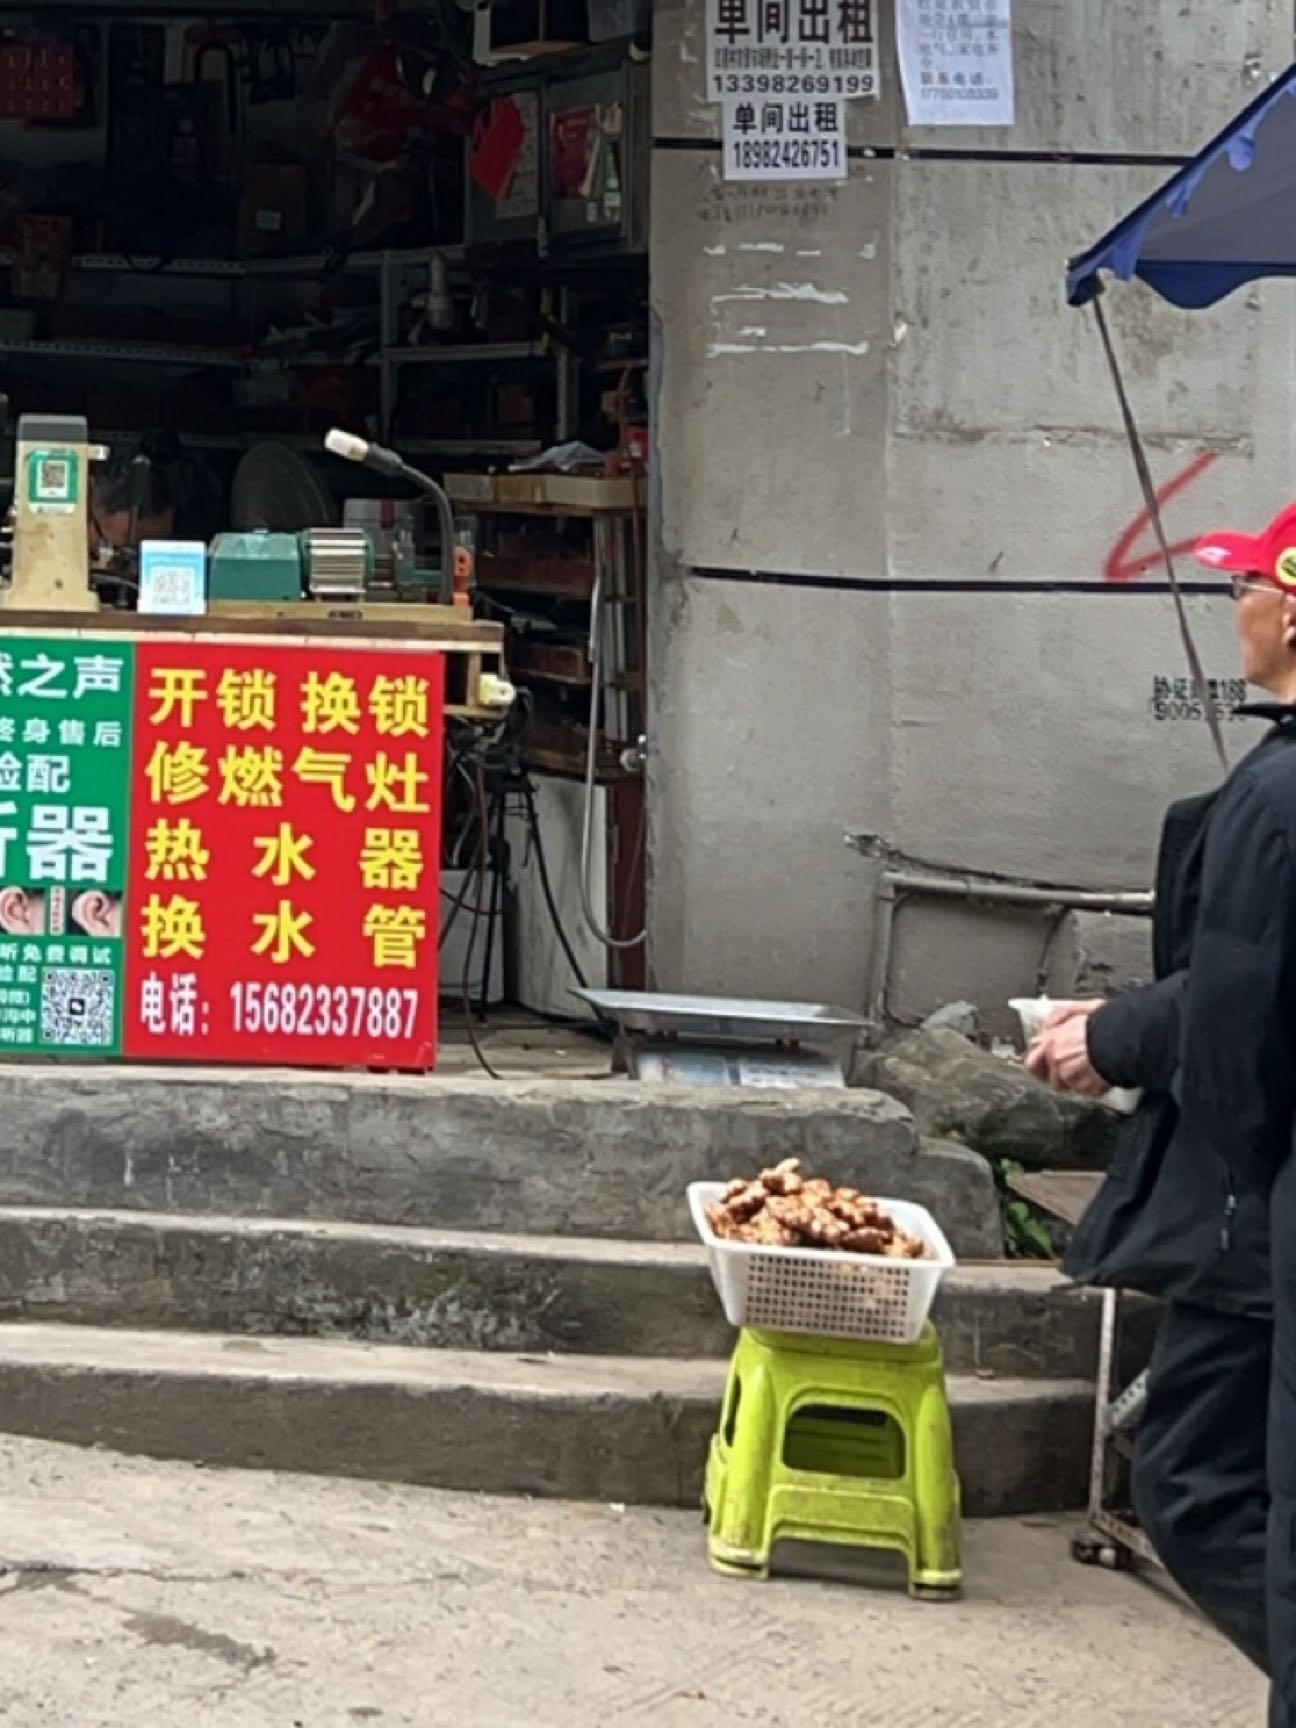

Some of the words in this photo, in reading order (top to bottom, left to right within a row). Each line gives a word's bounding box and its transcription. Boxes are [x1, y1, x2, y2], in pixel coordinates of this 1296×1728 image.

[713, 74, 874, 94] 13398269199
[733, 102, 839, 135] 单间出租
[734, 138, 840, 169] 18982426751
[149, 668, 277, 731] 开锁
[301, 672, 430, 738] 换锁
[144, 742, 431, 815] 修燃气灶
[229, 980, 419, 1040] 15682337887
